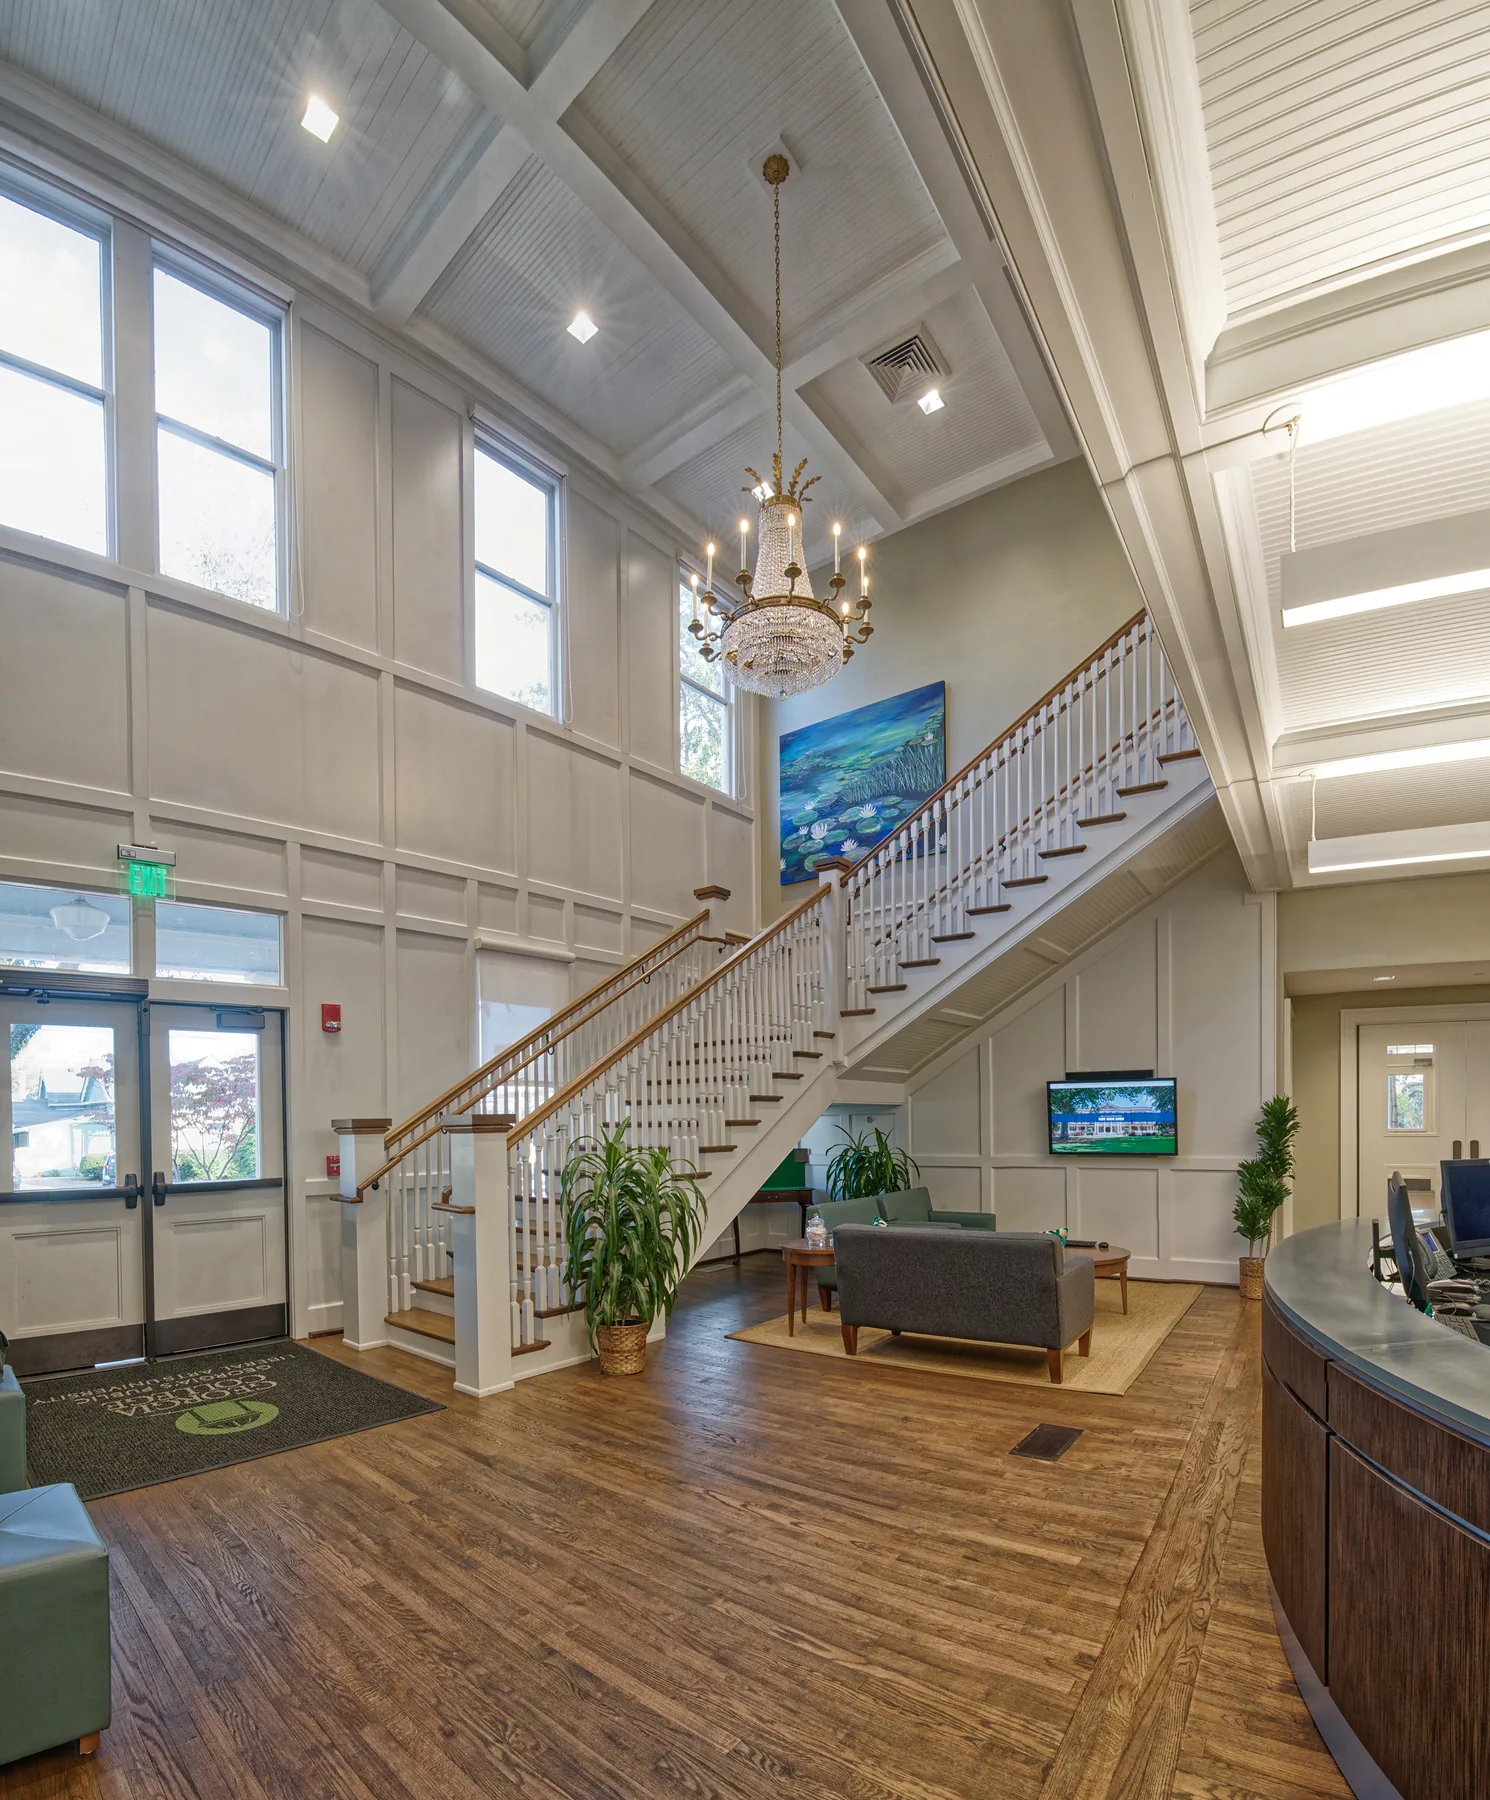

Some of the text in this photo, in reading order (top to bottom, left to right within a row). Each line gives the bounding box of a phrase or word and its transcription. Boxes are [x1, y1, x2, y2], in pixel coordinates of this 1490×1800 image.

[129, 864, 167, 897] EXIT
[32, 1354, 296, 1406] LIBERAL ARTS UNIVERSITY
[75, 1364, 271, 1405] GEORGIA'S PUBLIC
[101, 1374, 266, 1410] COLLEGE
[111, 1380, 277, 1416] GEORGIA
